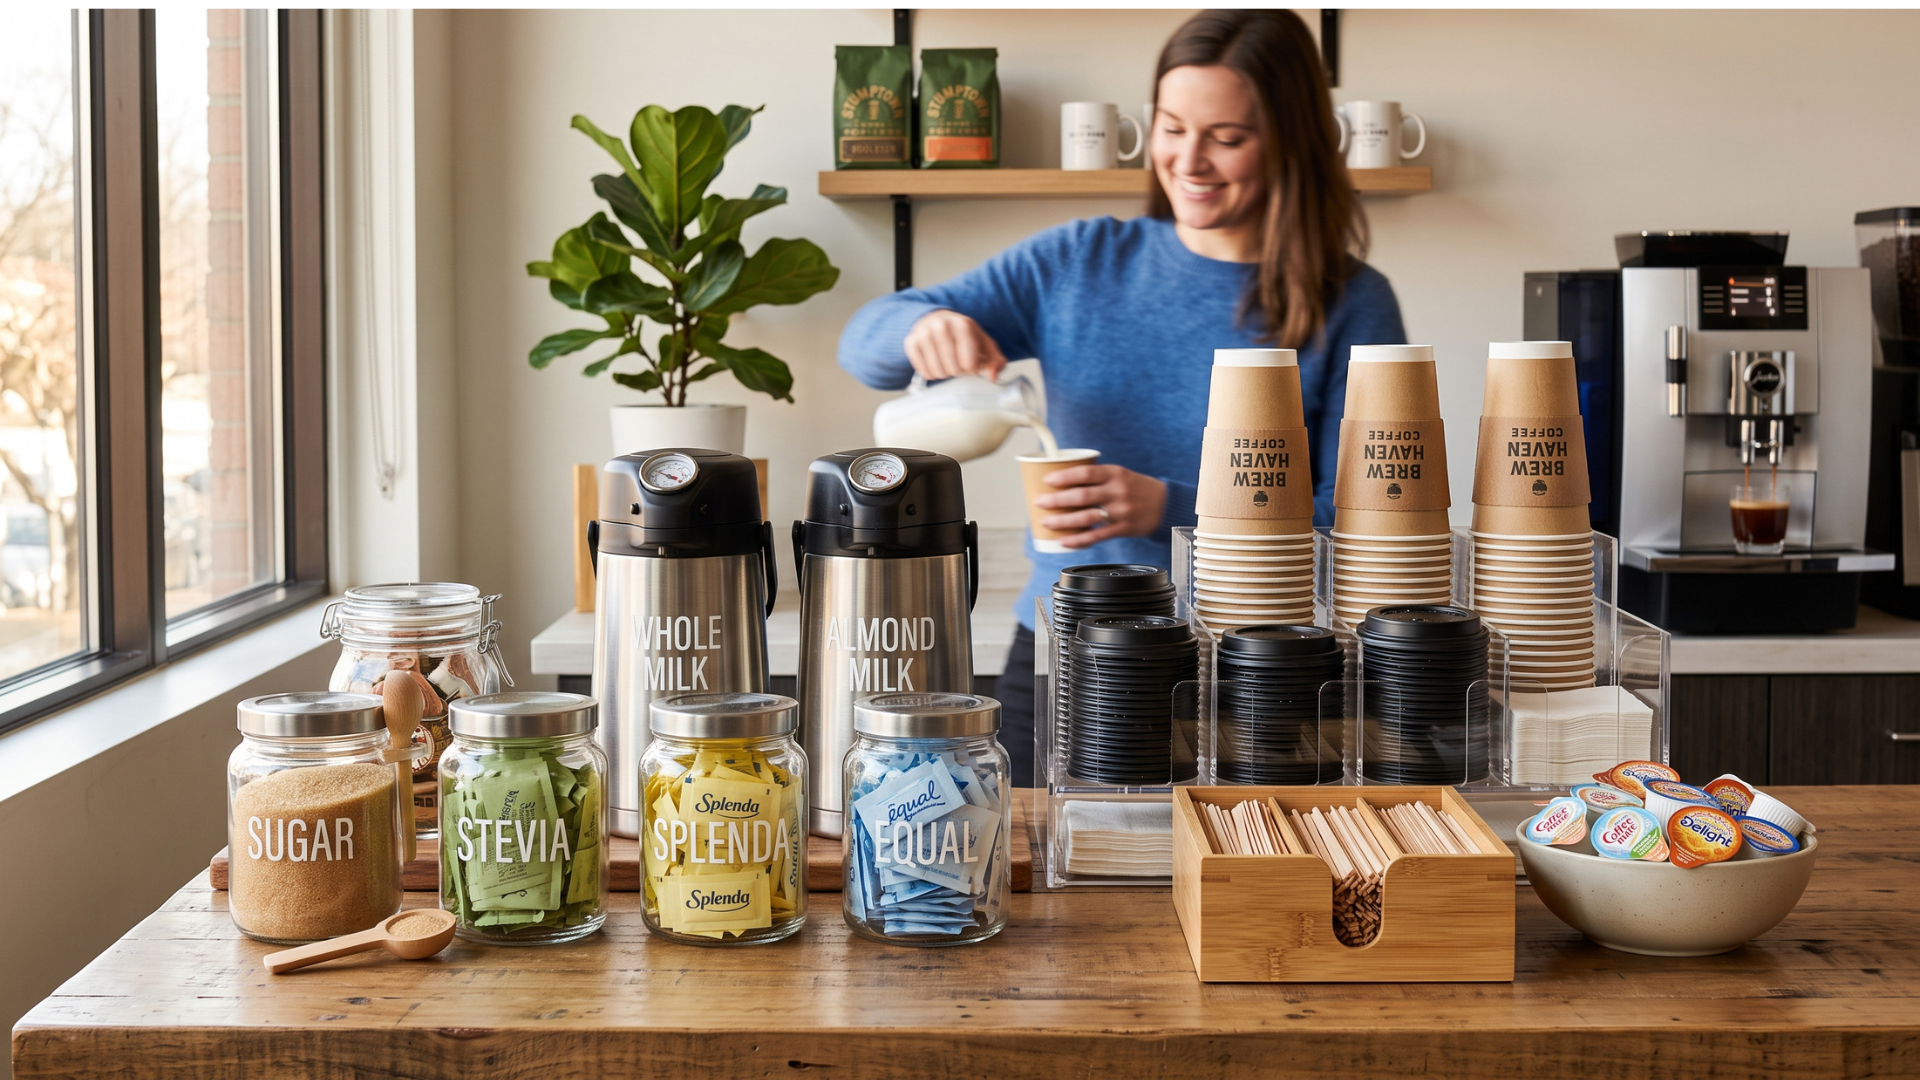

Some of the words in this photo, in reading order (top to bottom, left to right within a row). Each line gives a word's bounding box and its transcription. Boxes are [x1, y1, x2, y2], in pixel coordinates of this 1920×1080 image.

[1369, 431, 1420, 440] COFFEE
[1512, 428, 1563, 437] COFFEE
[1234, 439, 1285, 448] COFFEE
[1364, 445, 1424, 460] HAVEN
[1508, 442, 1567, 456] HAVEN
[1230, 453, 1289, 468] HAVEN
[1511, 461, 1564, 475] BREW
[1233, 472, 1286, 487] BREW
[1366, 464, 1421, 479] BREW
[631, 615, 721, 651] WHOLE
[826, 617, 936, 651] ALMOND
[644, 656, 709, 691] MILK
[849, 657, 914, 692] MILK
[695, 793, 760, 814] Splenda
[248, 816, 354, 862] SUGAR
[457, 817, 571, 863] STEVIA
[653, 817, 790, 864] SPLENDA
[1680, 816, 1733, 847] Delight
[875, 820, 978, 868] EQUAL
[686, 889, 750, 910] Splenda
